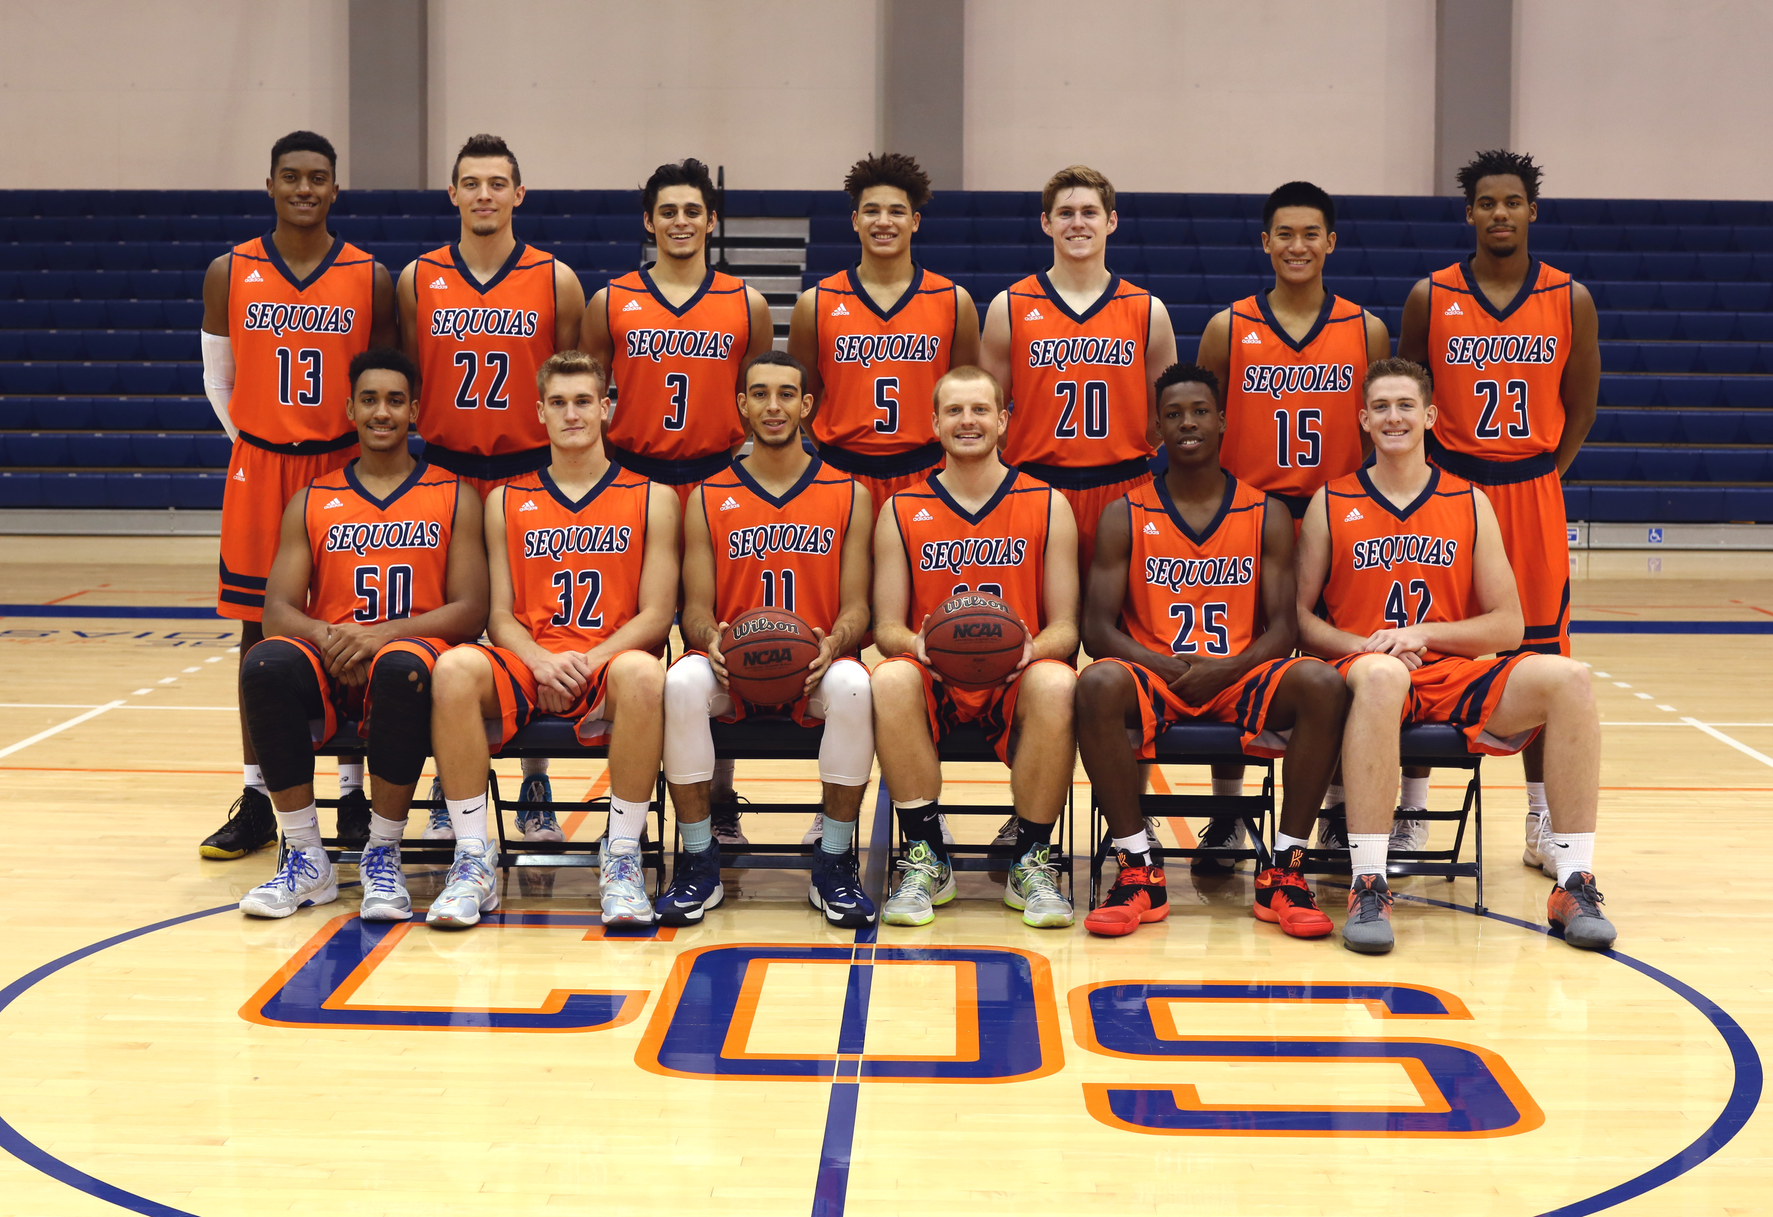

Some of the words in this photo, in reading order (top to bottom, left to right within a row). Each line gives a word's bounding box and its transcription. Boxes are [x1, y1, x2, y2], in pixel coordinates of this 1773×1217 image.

[244, 302, 355, 338] SEQUOIAS
[431, 307, 539, 342] SEQUOIAS
[626, 328, 735, 363] SEQUOIAS
[834, 333, 941, 369] SEQUOIAS
[1029, 336, 1136, 372] SEQUOIAS
[1445, 334, 1558, 372] SEQUOIAS
[275, 347, 323, 406] 13
[454, 350, 510, 410] 22
[1242, 363, 1354, 400] SEQUOIAS
[663, 372, 689, 431] 3
[874, 376, 899, 434] 5
[1054, 380, 1109, 439] 20
[1474, 379, 1531, 440] 23
[1274, 408, 1322, 468] 15
[719, 503, 740, 511] adidas
[1344, 514, 1364, 523] adidas
[326, 520, 441, 557] SEQUOIAS
[524, 524, 632, 562] SEQUOIAS
[728, 523, 835, 560] SEQUOIAS
[920, 536, 1028, 575] SEQUOIAS
[1352, 534, 1458, 572] SEQUOIAS
[353, 564, 413, 622] 50
[761, 568, 796, 614] 11
[1145, 556, 1255, 594] SEQUOIAS
[550, 569, 603, 629] 32
[942, 595, 1010, 615] Wilson
[1384, 578, 1433, 629] 42
[732, 617, 800, 641] Wilson
[953, 623, 1003, 639] NCAA
[1168, 602, 1230, 656] 25
[743, 648, 793, 667] NCAA
[237, 909, 1546, 1139] COS
